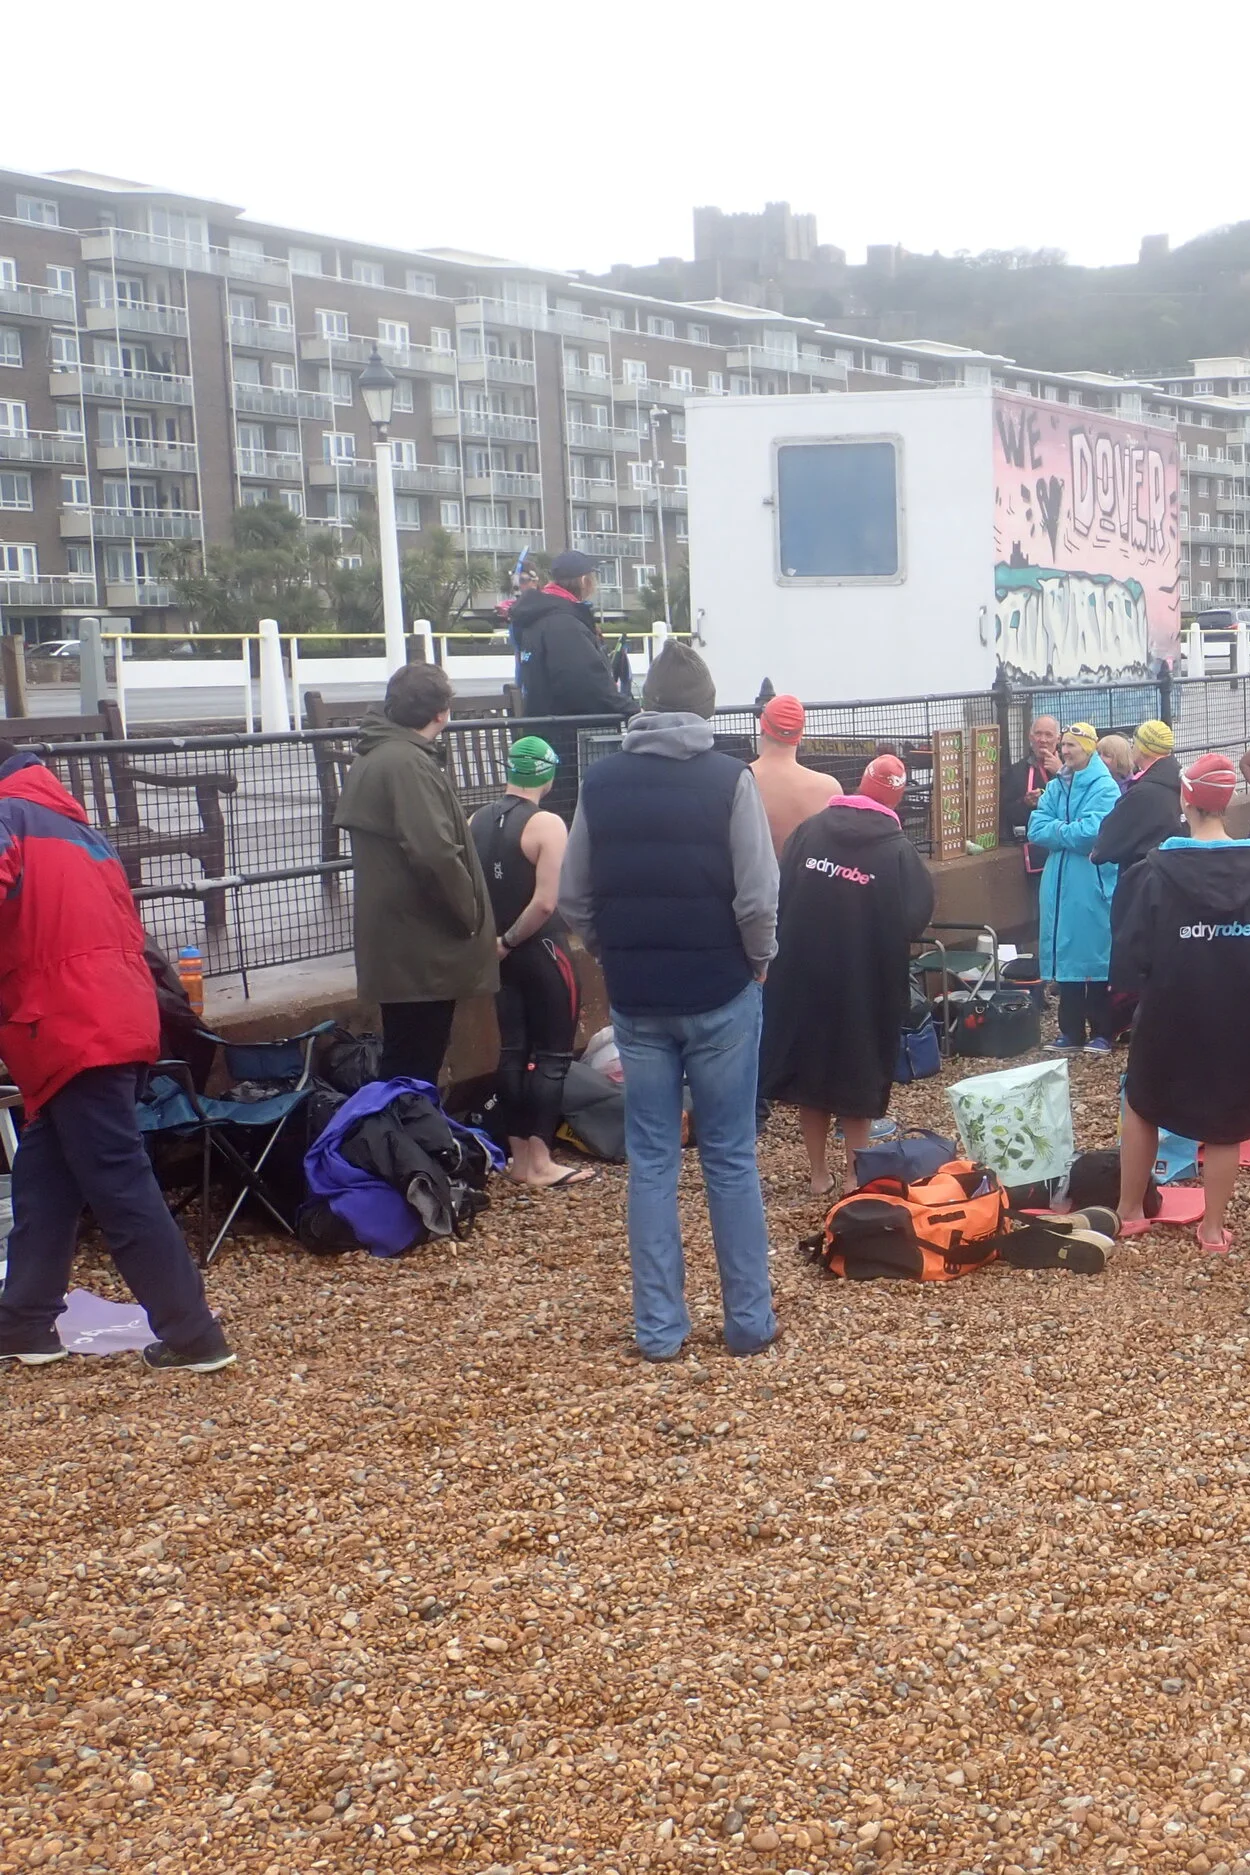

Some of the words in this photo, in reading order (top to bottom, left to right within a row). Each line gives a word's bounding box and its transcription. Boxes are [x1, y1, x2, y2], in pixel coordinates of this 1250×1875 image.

[996, 408, 1042, 470] WE
[1069, 425, 1165, 553] DOVER
[816, 858, 870, 885] dryrobe
